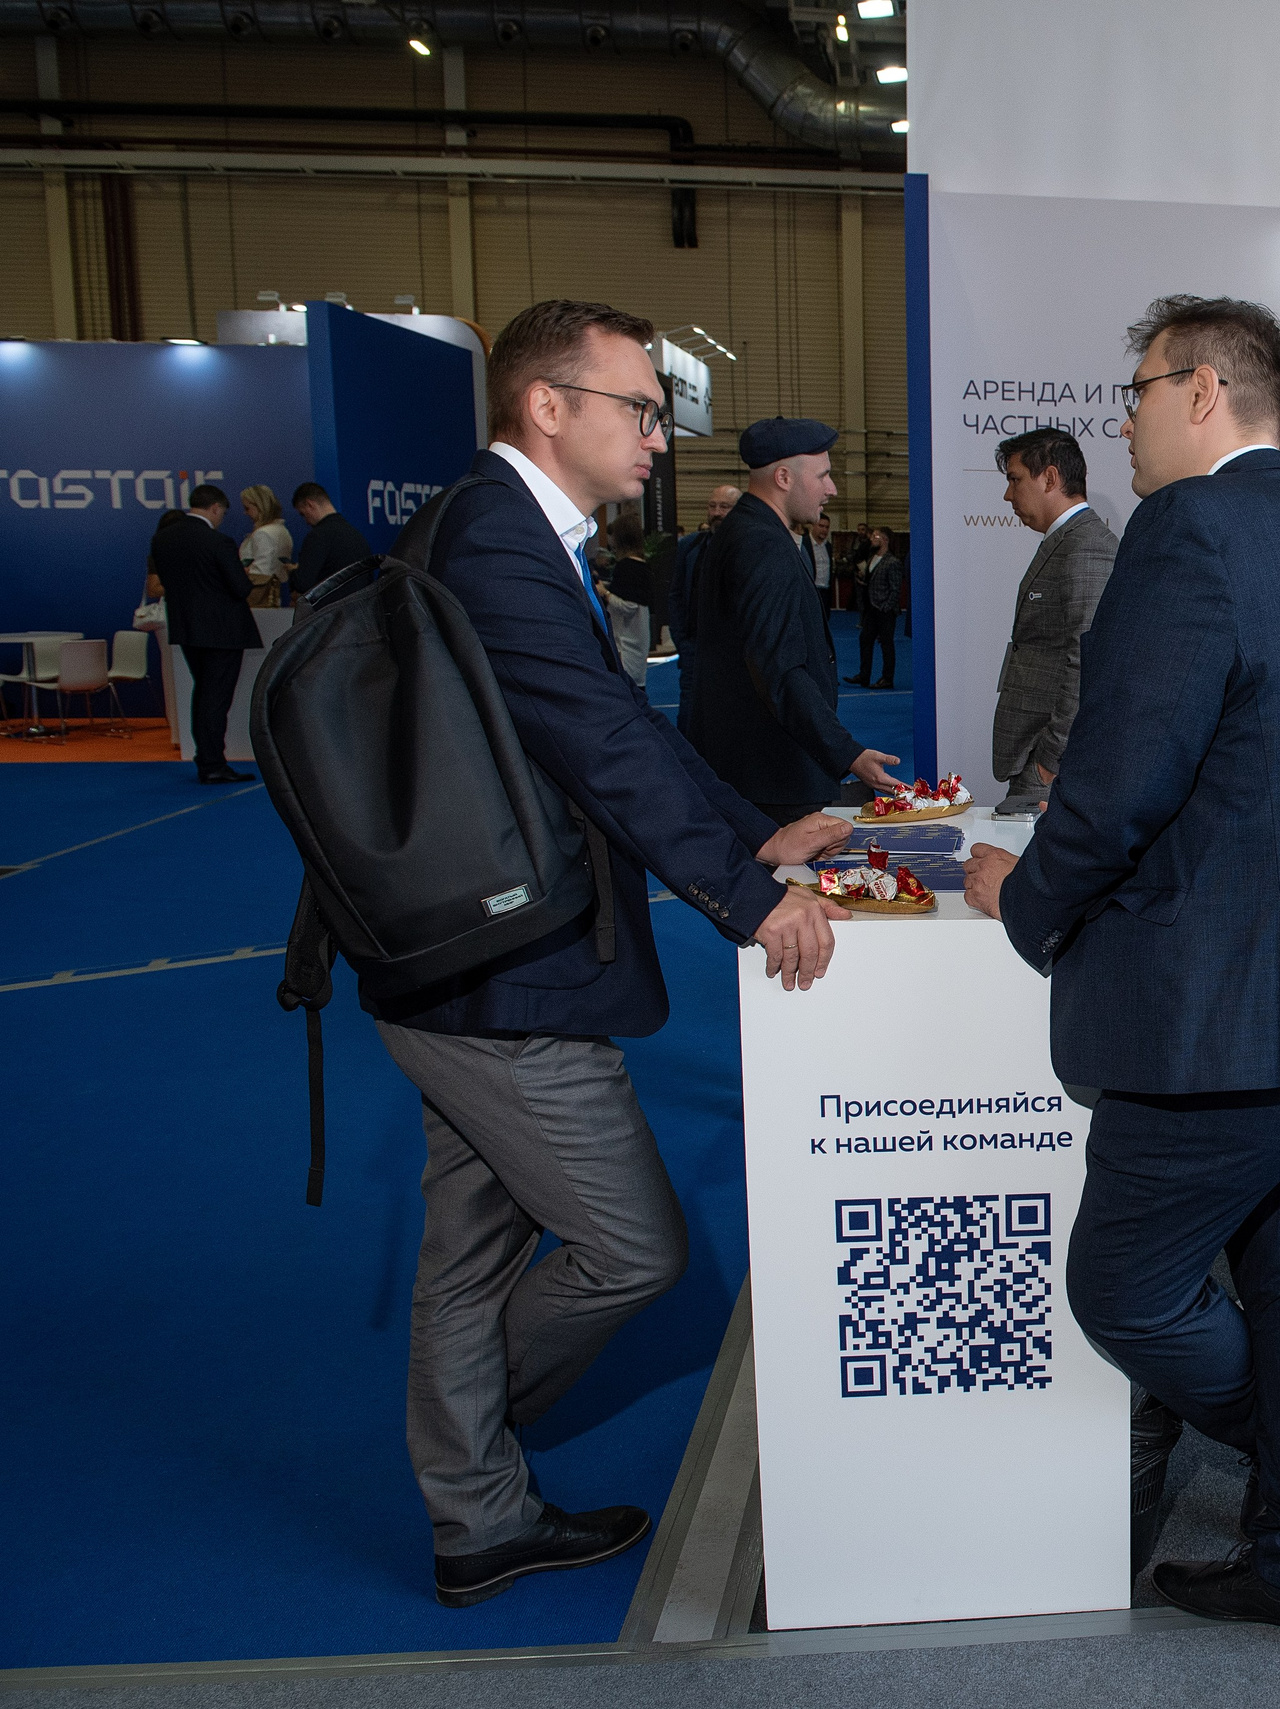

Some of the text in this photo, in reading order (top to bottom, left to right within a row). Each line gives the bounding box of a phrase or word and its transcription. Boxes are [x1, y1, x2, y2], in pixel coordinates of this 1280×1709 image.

[962, 380, 1076, 407] АРЕНДА
[1085, 383, 1102, 404] И
[963, 414, 1095, 438] ЧАСТНЫХ
[819, 1090, 1063, 1124] Присоединяйся
[810, 1129, 1074, 1155] к нашей команде
